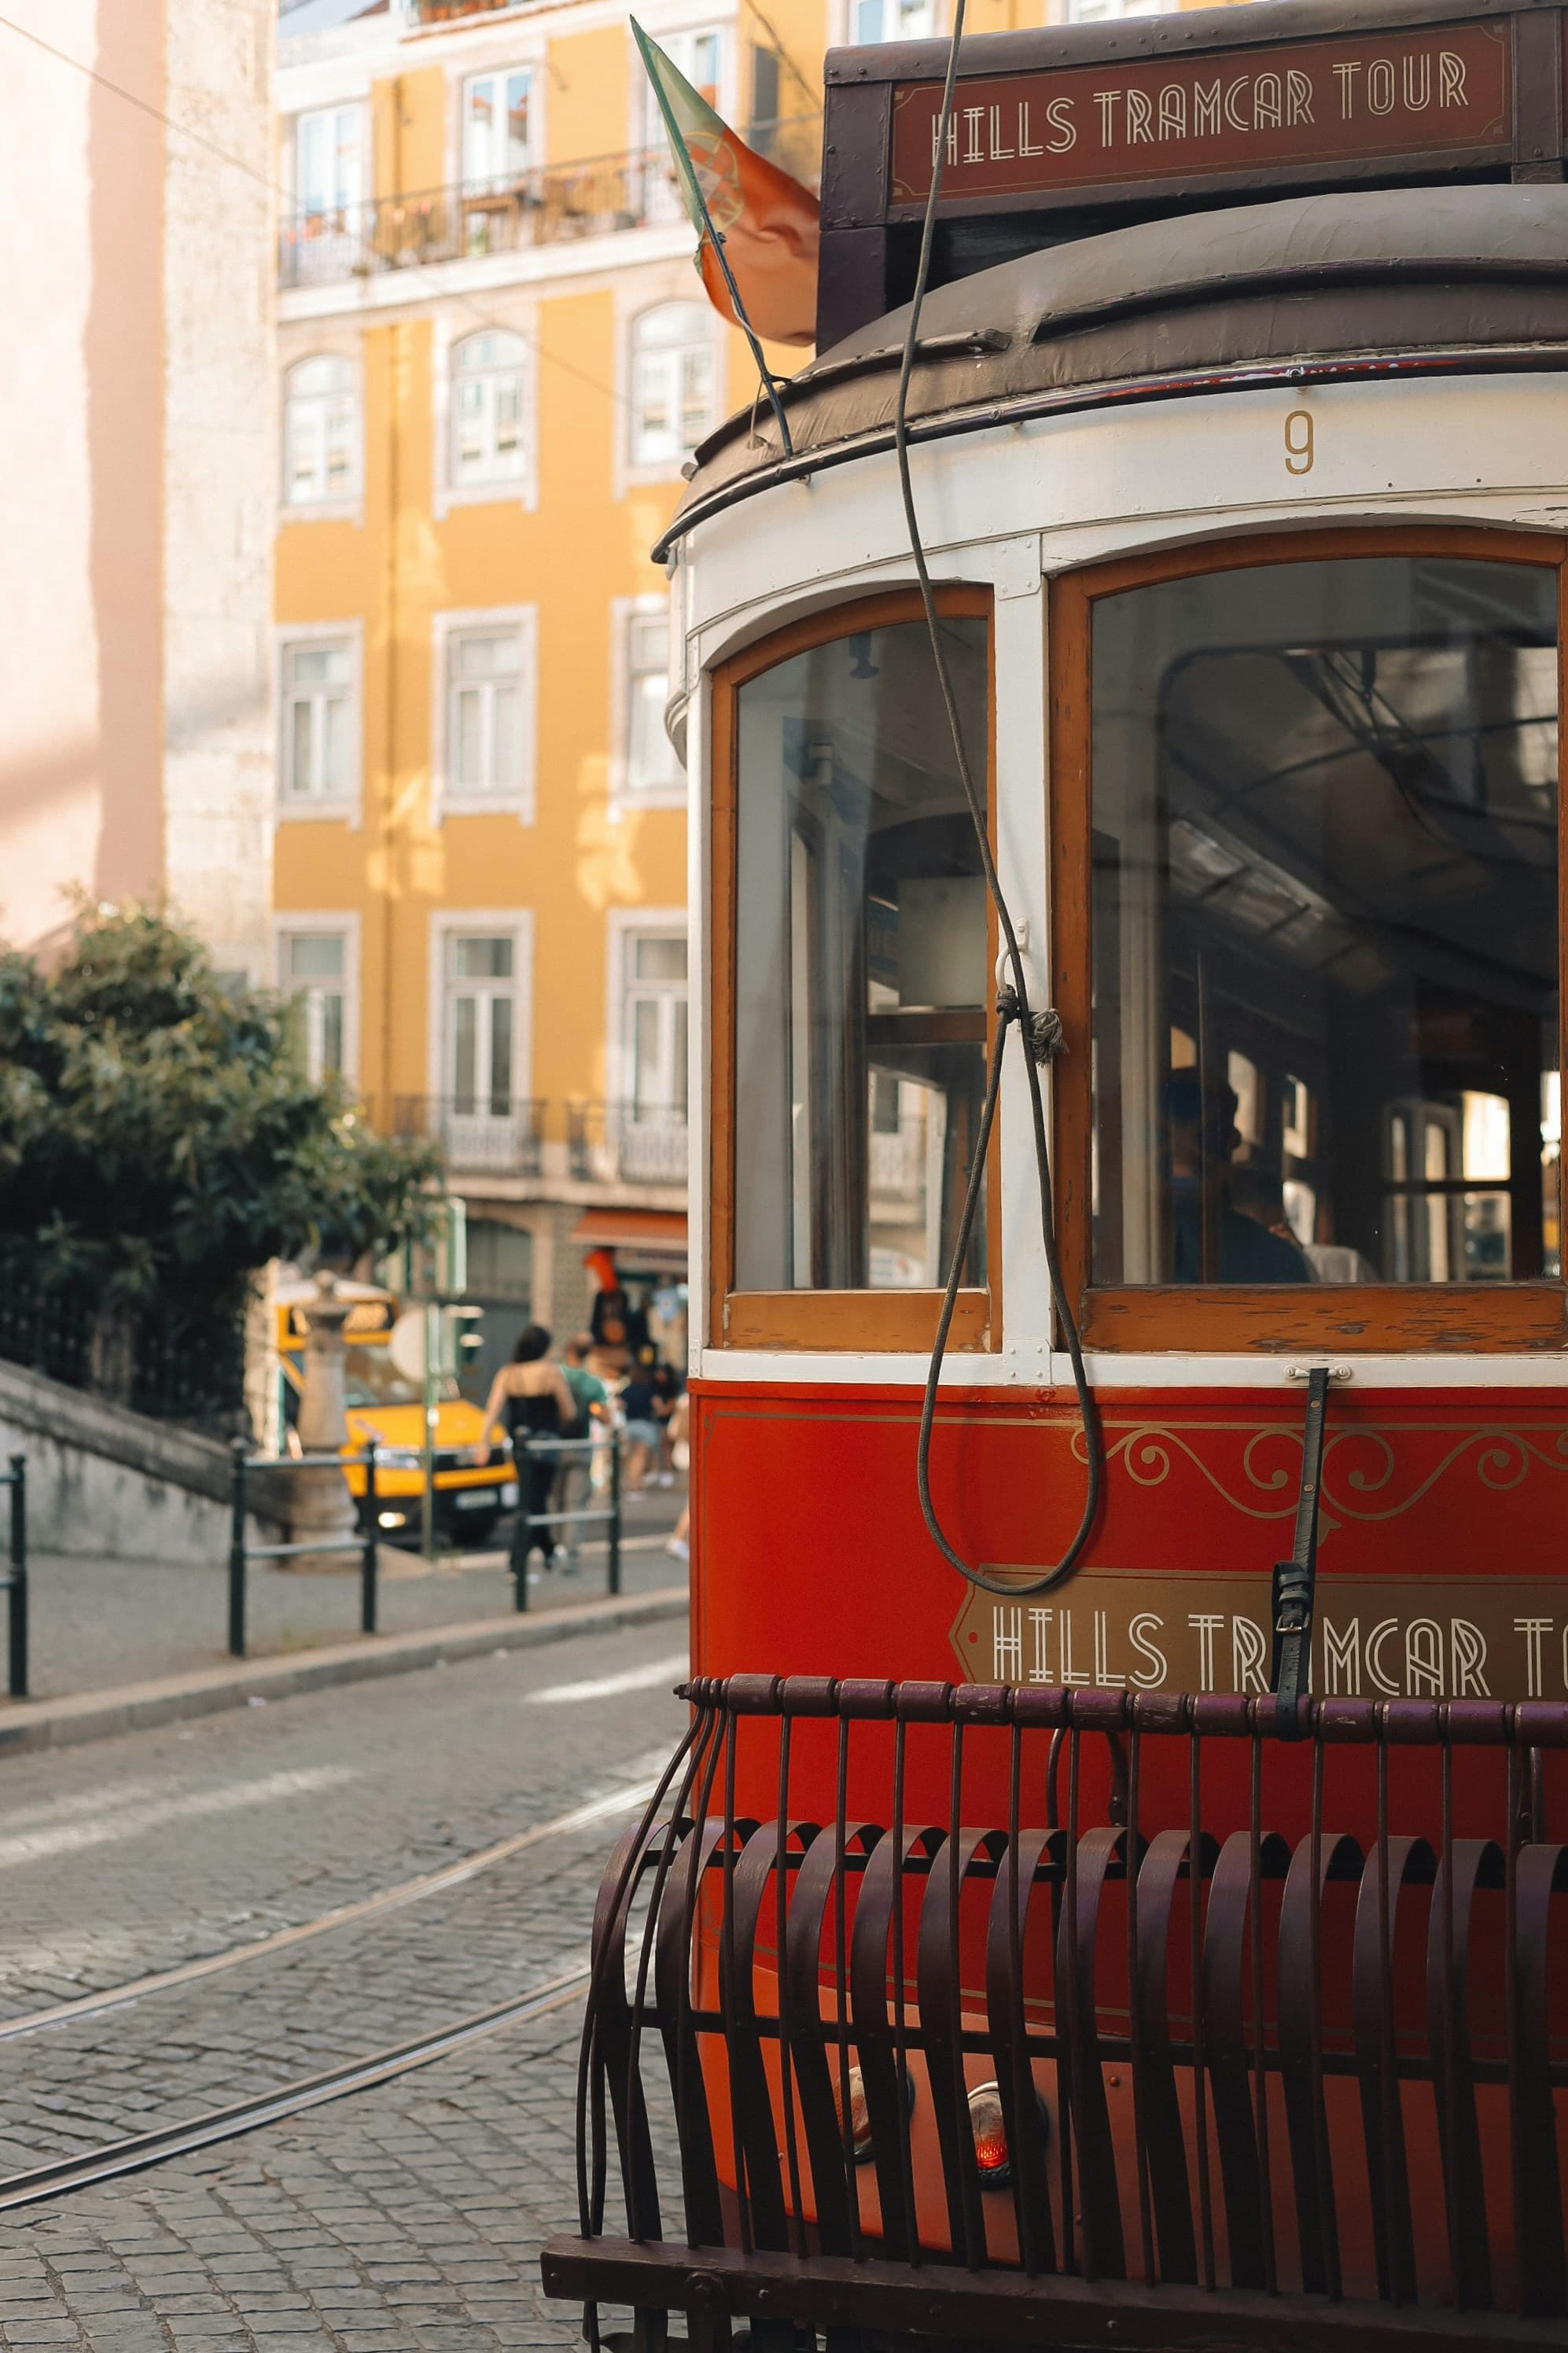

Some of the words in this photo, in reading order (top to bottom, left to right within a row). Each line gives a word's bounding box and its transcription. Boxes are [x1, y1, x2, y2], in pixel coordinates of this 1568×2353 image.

[932, 98, 1077, 168] HILLS
[1093, 70, 1315, 147] TRAMCAR
[1333, 52, 1469, 120] TOUR
[1285, 410, 1314, 475] 9
[993, 1606, 1168, 1689] HILLS
[1187, 1614, 1491, 1696] TRMCAR
[1513, 1618, 1568, 1696] T
